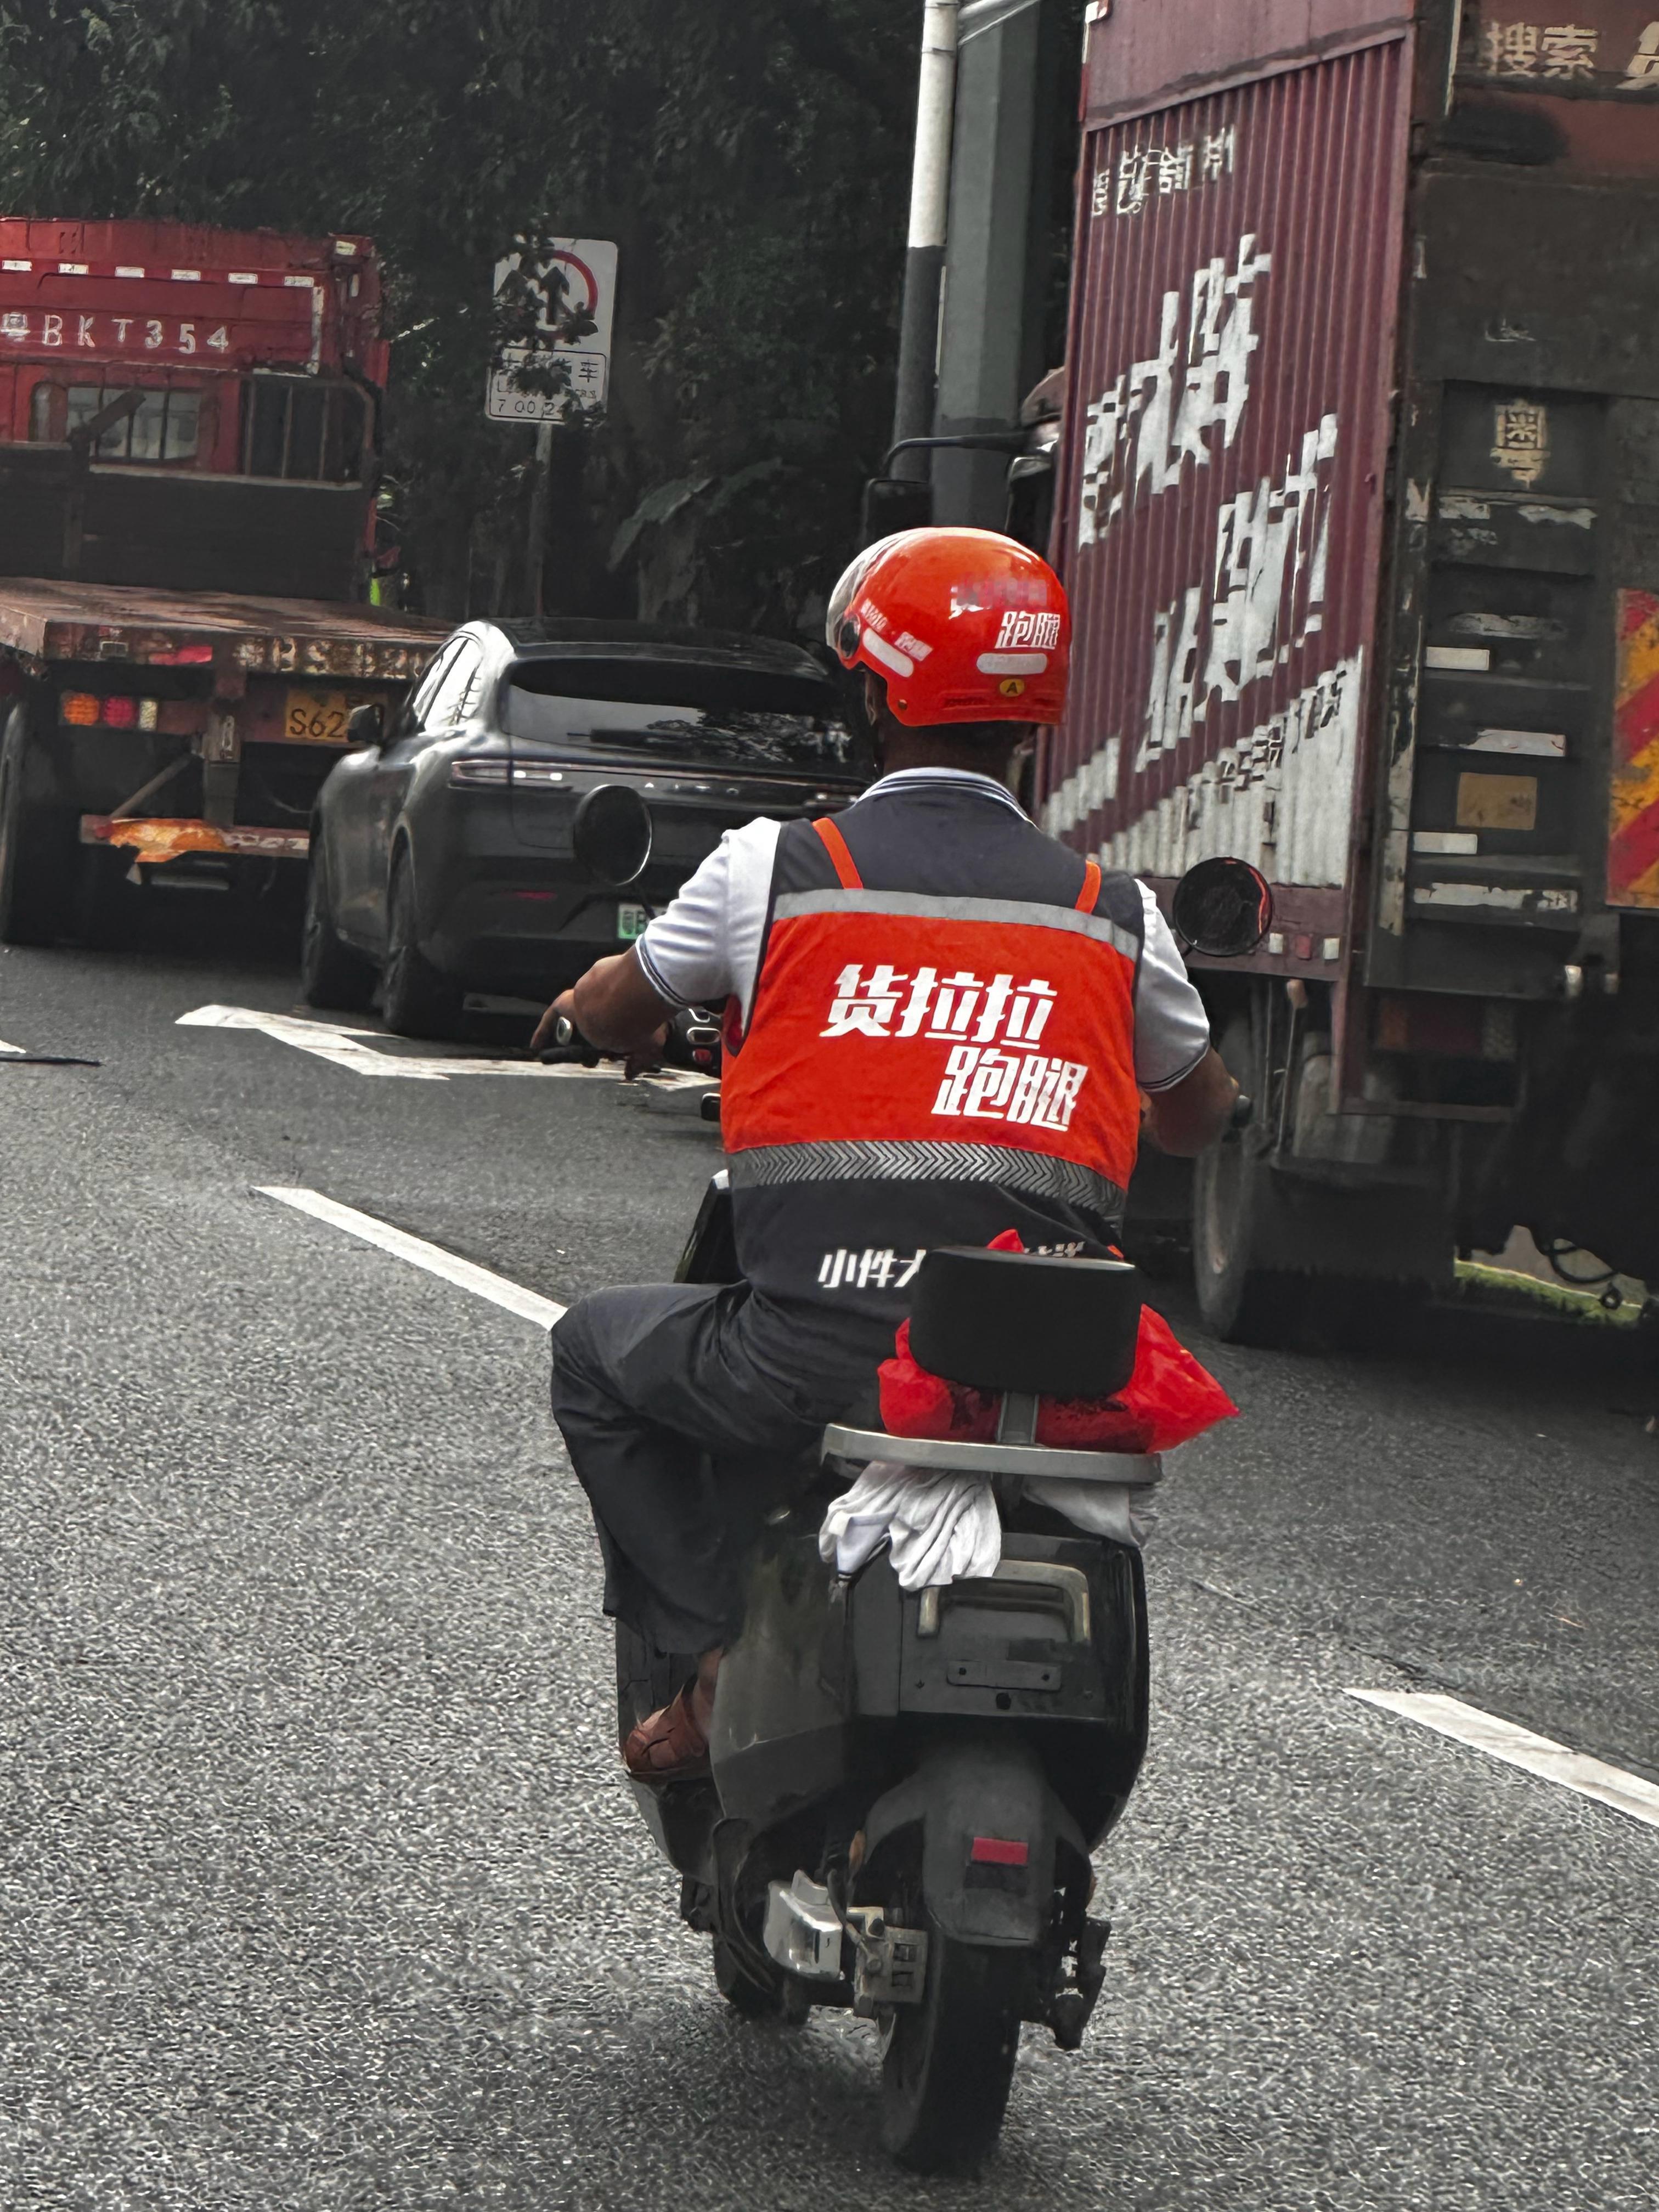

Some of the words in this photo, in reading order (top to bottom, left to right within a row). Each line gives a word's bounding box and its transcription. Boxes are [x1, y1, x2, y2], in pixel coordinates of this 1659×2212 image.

[994, 611, 1061, 650] 跑腿
[819, 963, 1058, 1049] 货拉拉
[931, 1045, 1088, 1132] 跑腿
